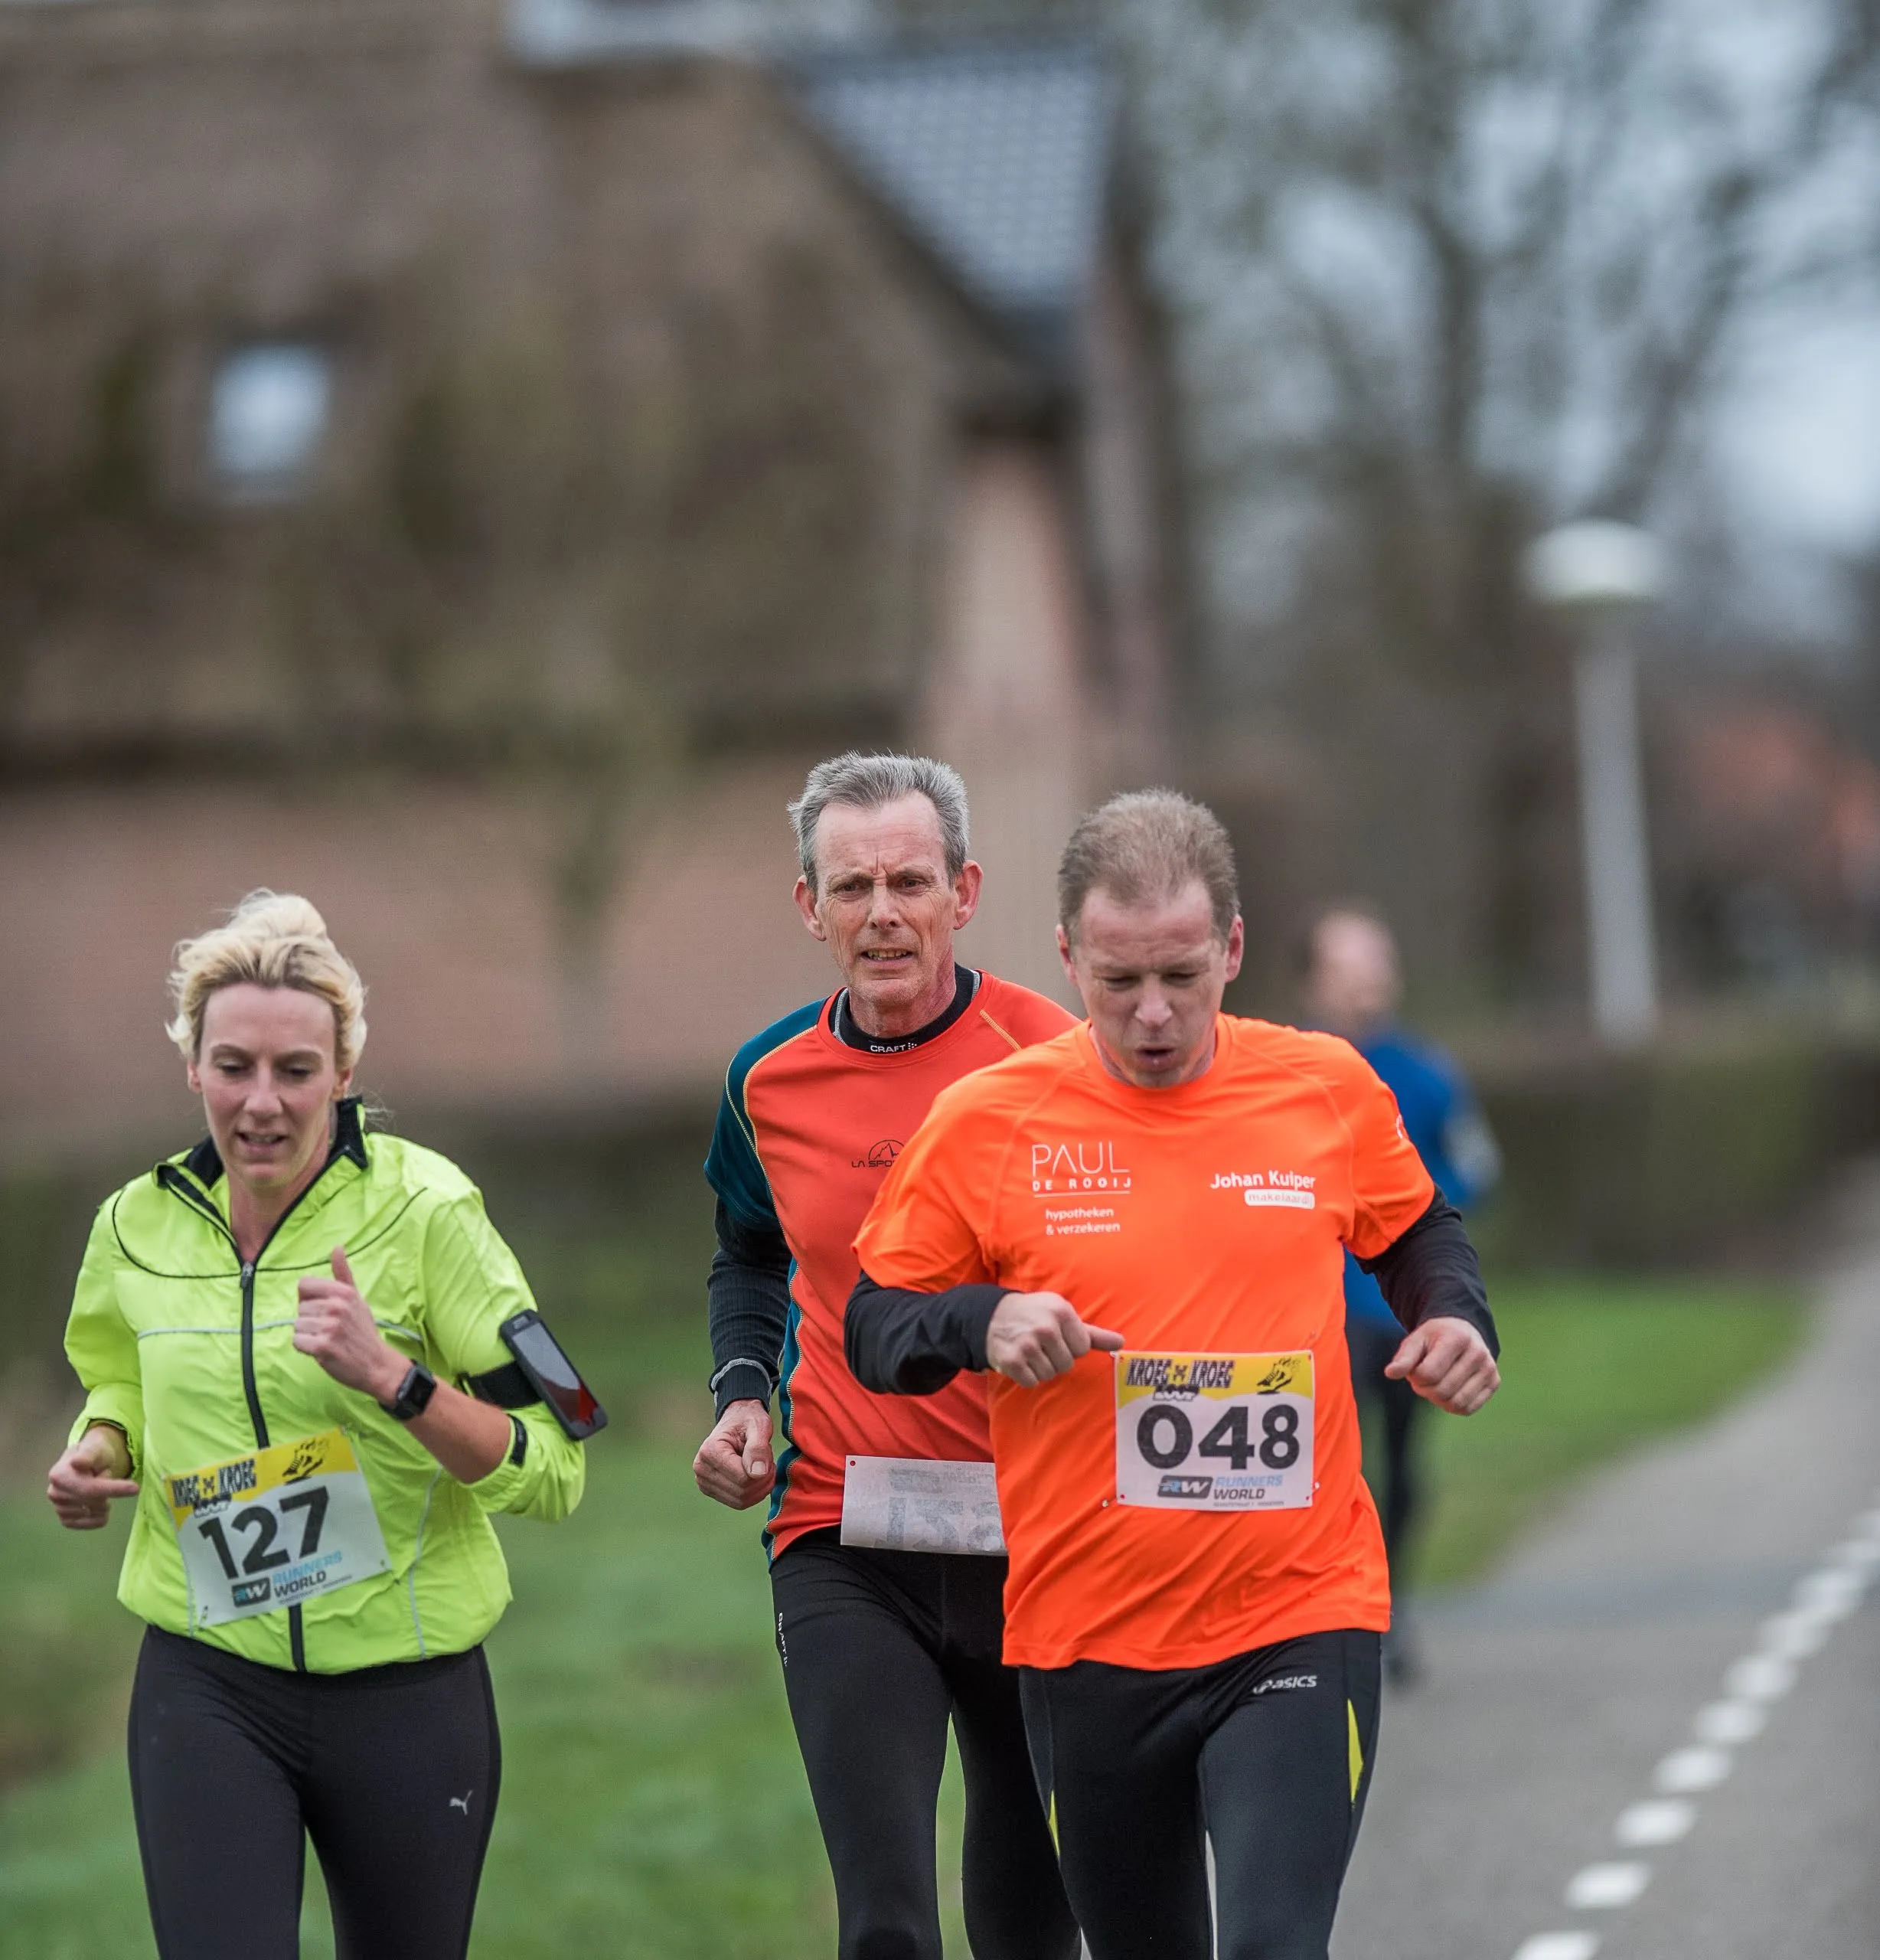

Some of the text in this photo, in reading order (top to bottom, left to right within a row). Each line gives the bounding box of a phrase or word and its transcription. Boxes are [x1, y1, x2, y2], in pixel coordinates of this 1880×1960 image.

[870, 1044, 906, 1053] CRAFT
[851, 1160, 865, 1168] LA
[1032, 1141, 1131, 1177] PAUL
[1033, 1177, 1131, 1191] DE ROOIJ
[1210, 1170, 1316, 1191] Johan Kuiper
[1045, 1207, 1114, 1222] hypotheken
[1046, 1221, 1121, 1236] & verzekeren
[1137, 1404, 1300, 1470] 048
[1215, 1475, 1284, 1488] RUNNERS
[1213, 1488, 1265, 1500] WORLD
[197, 1485, 329, 1580] 127
[272, 1550, 342, 1583] RUNNERS
[273, 1570, 327, 1598] WORLD
